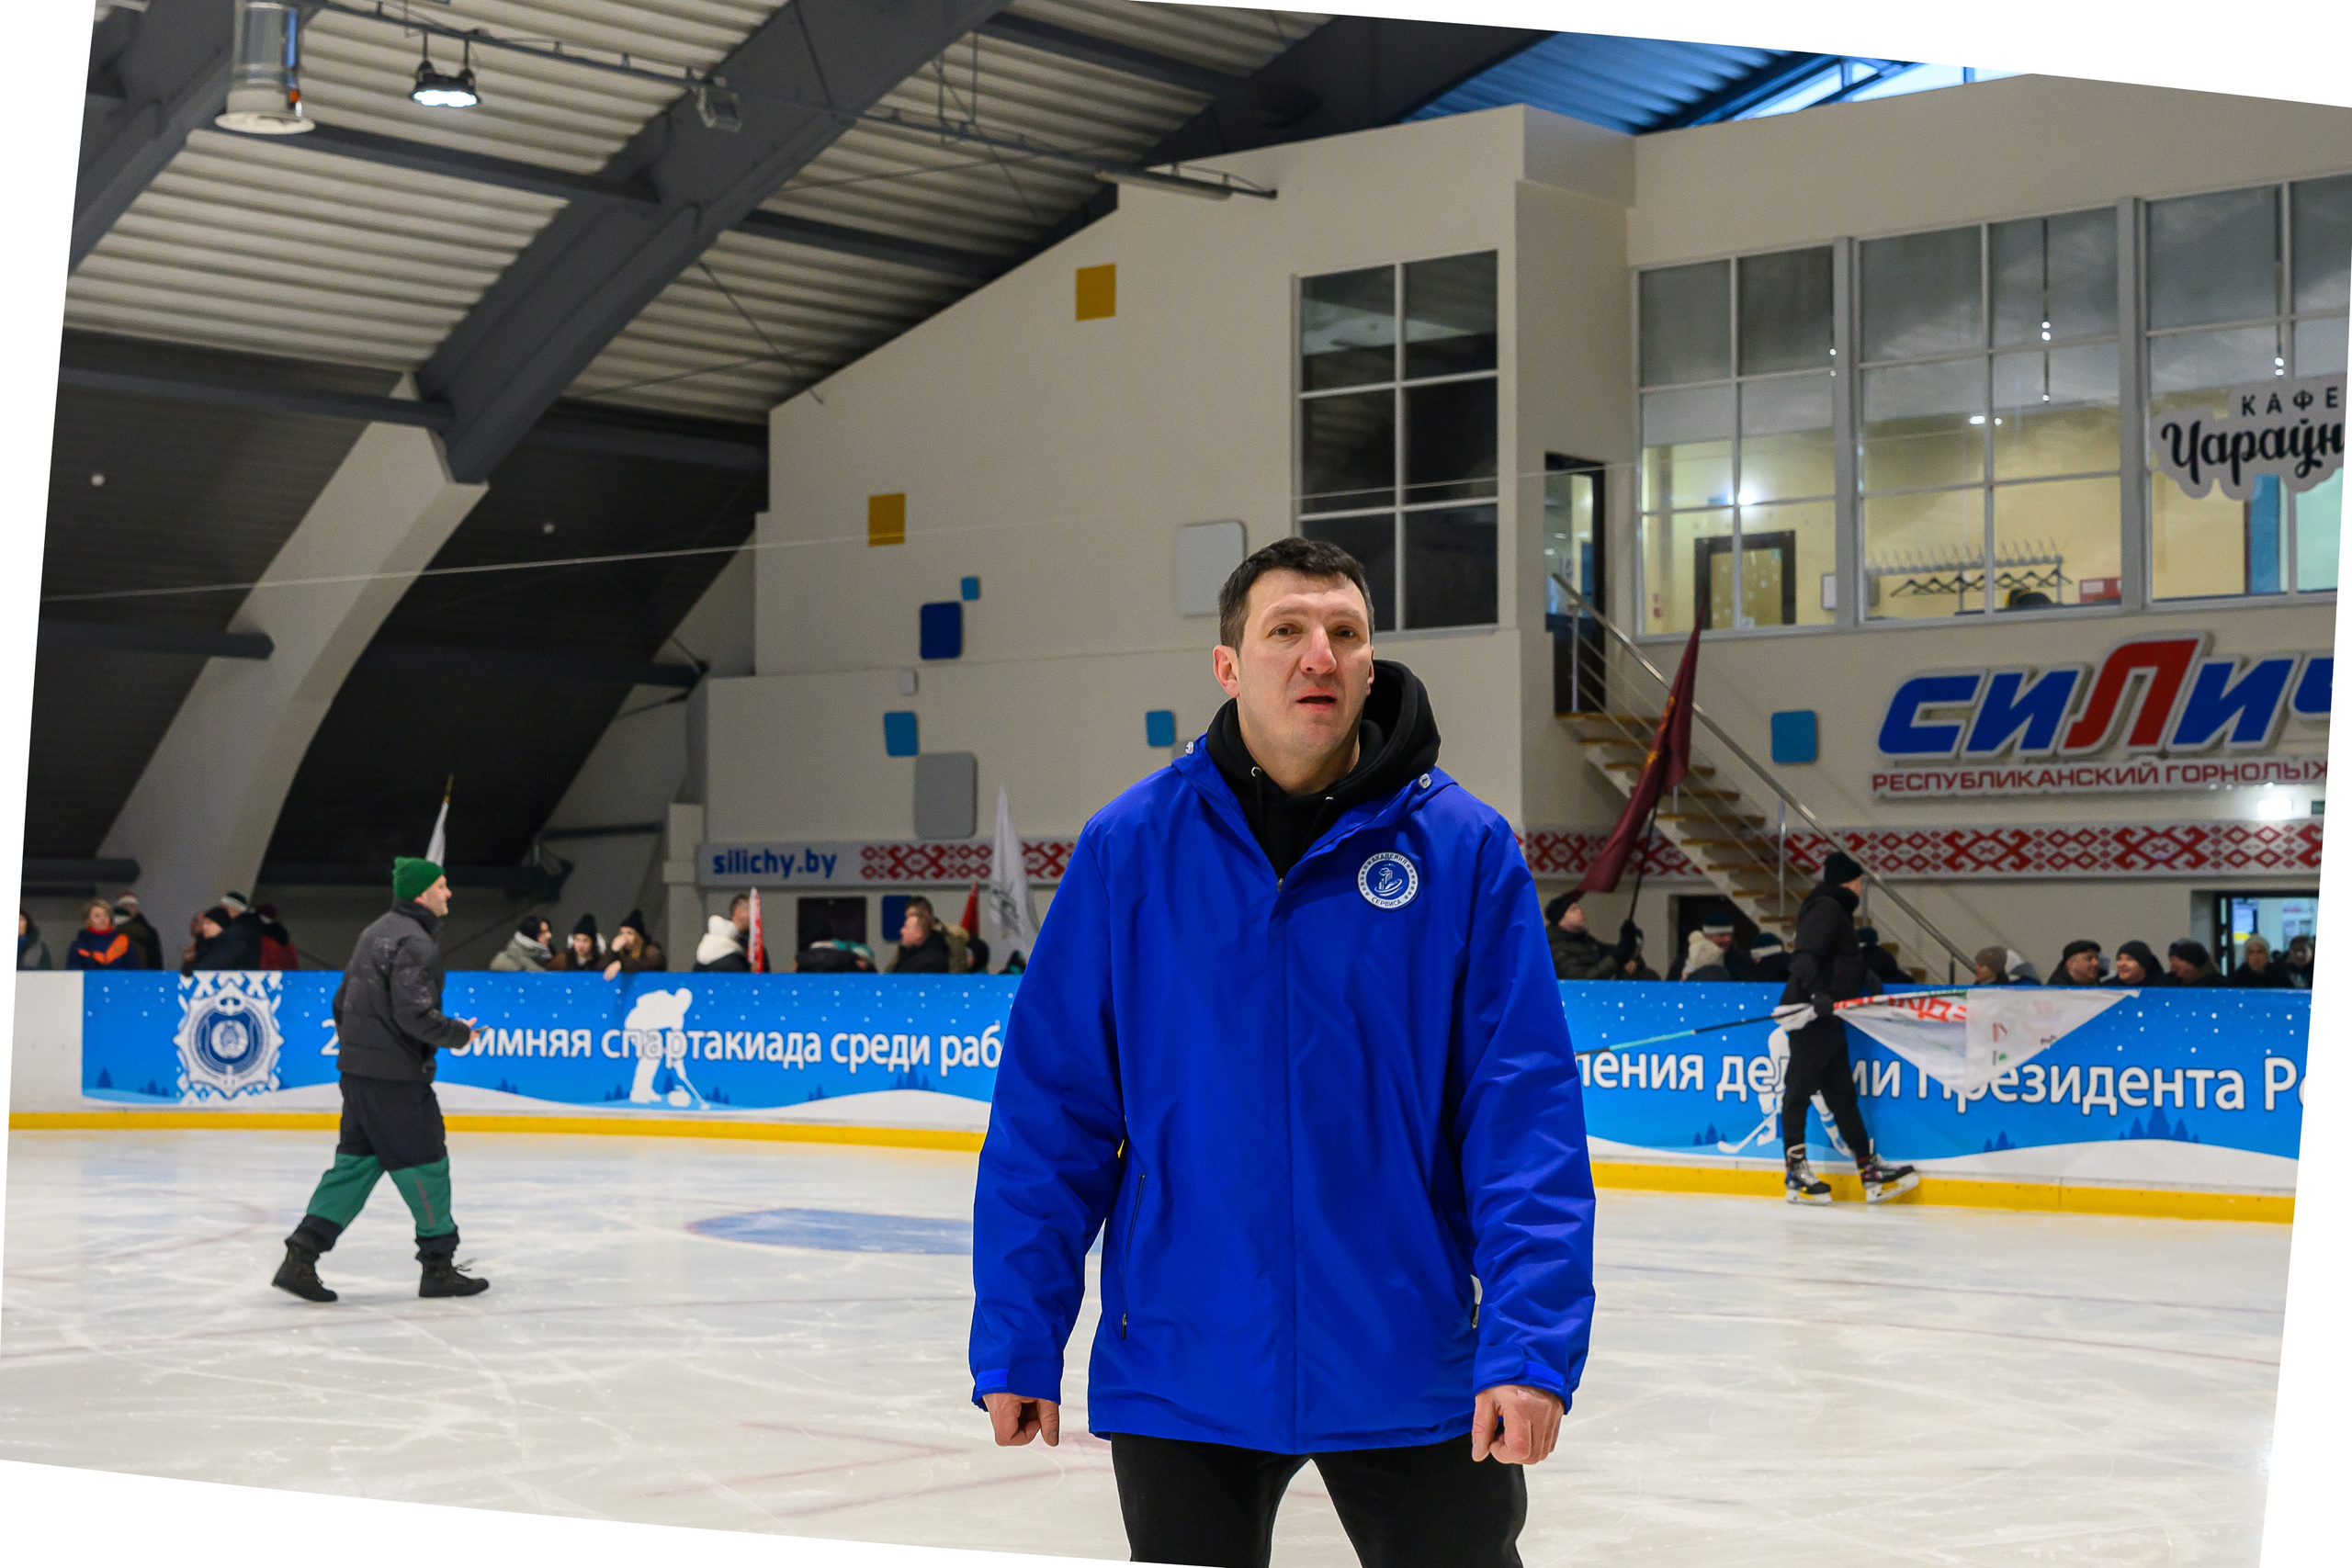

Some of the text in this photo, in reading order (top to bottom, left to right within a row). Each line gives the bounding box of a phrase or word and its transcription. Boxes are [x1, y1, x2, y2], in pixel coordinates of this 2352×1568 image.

[2242, 386, 2339, 416] КАФЕ
[1871, 761, 2159, 791] РЕСПУБЛИКАНСКИЙ
[713, 848, 837, 879] silichy.by
[1371, 853, 1408, 865] АКАДЕМИЯ
[1371, 897, 1402, 907] СЕРВИСА
[601, 1029, 821, 1070] спартакиада
[831, 1032, 931, 1073] среди
[2264, 1057, 2306, 1111] Р
